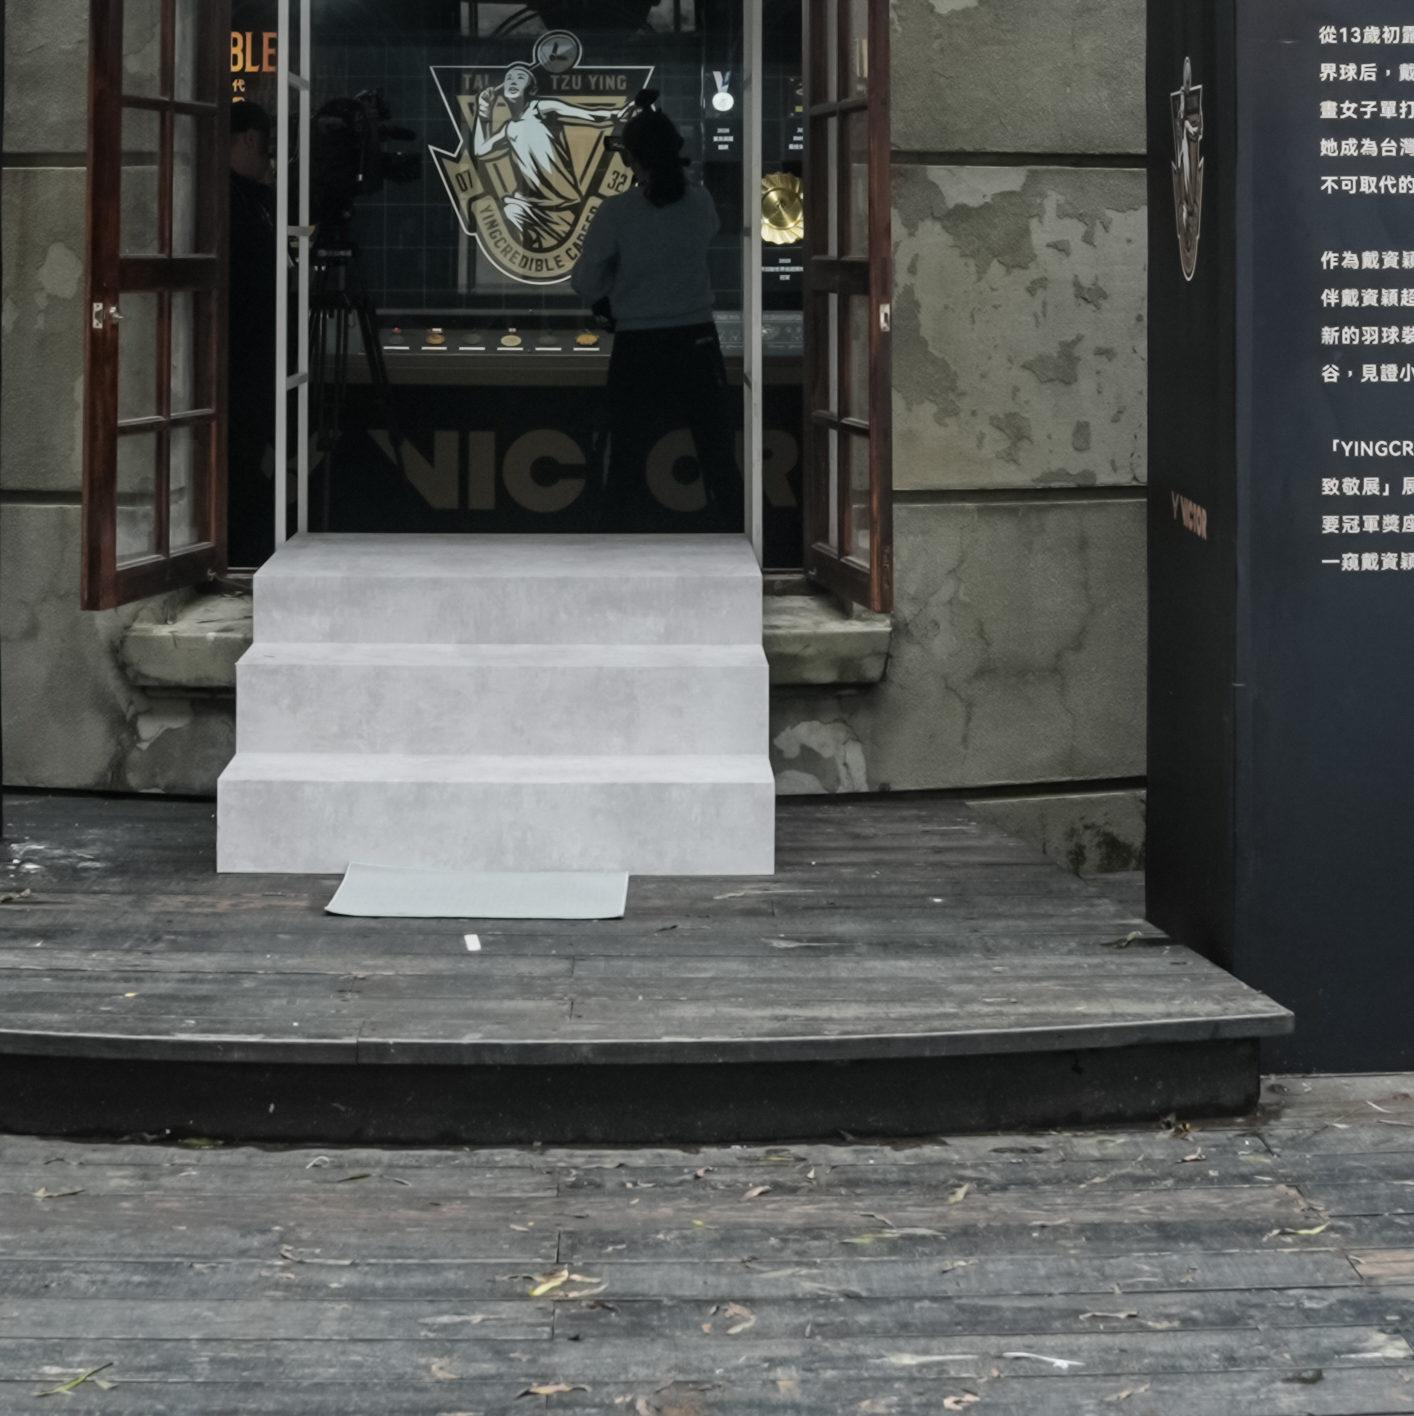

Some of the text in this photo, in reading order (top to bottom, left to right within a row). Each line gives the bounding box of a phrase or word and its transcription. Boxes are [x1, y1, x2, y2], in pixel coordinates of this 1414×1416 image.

[550, 75, 581, 90] TZU
[588, 75, 627, 90] YING
[455, 170, 474, 192] 07
[607, 170, 628, 192] 32
[479, 204, 565, 272] YINGCREDIBLE
[367, 428, 798, 513] VICOR
